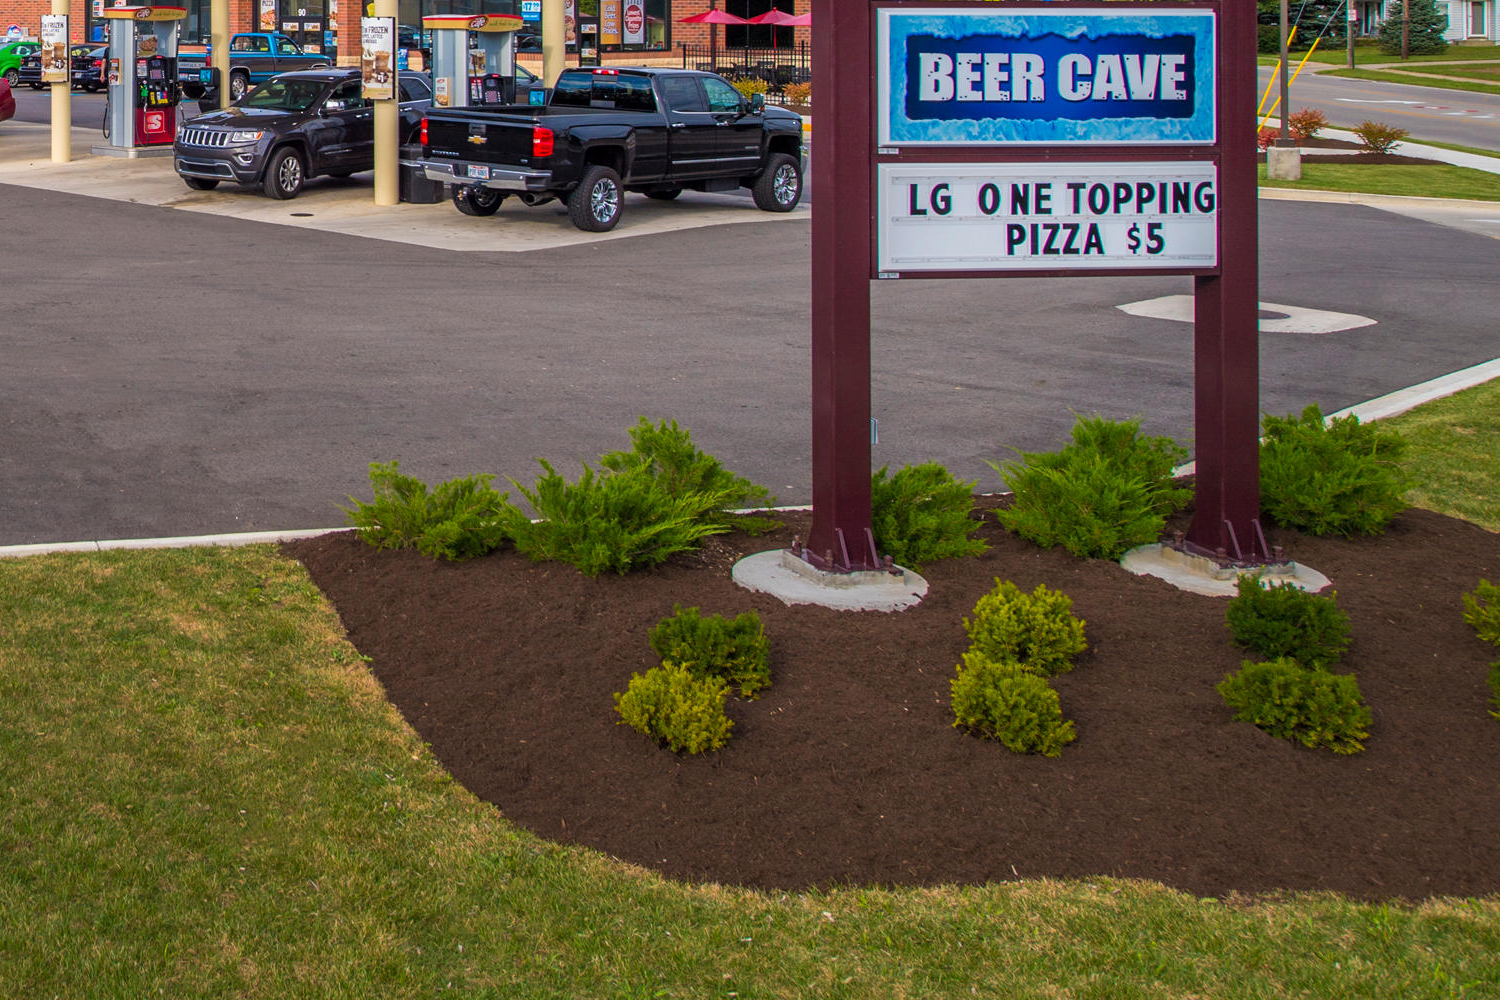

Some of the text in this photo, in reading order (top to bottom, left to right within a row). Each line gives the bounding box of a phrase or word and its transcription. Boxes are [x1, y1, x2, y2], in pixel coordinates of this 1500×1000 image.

[298, 8, 306, 16] 90
[368, 26, 388, 34] FROZEN
[919, 53, 1187, 101] BEER CAVE
[909, 181, 1215, 215] LG ONE TOPPING
[1006, 222, 1165, 255] PIZZA $5
